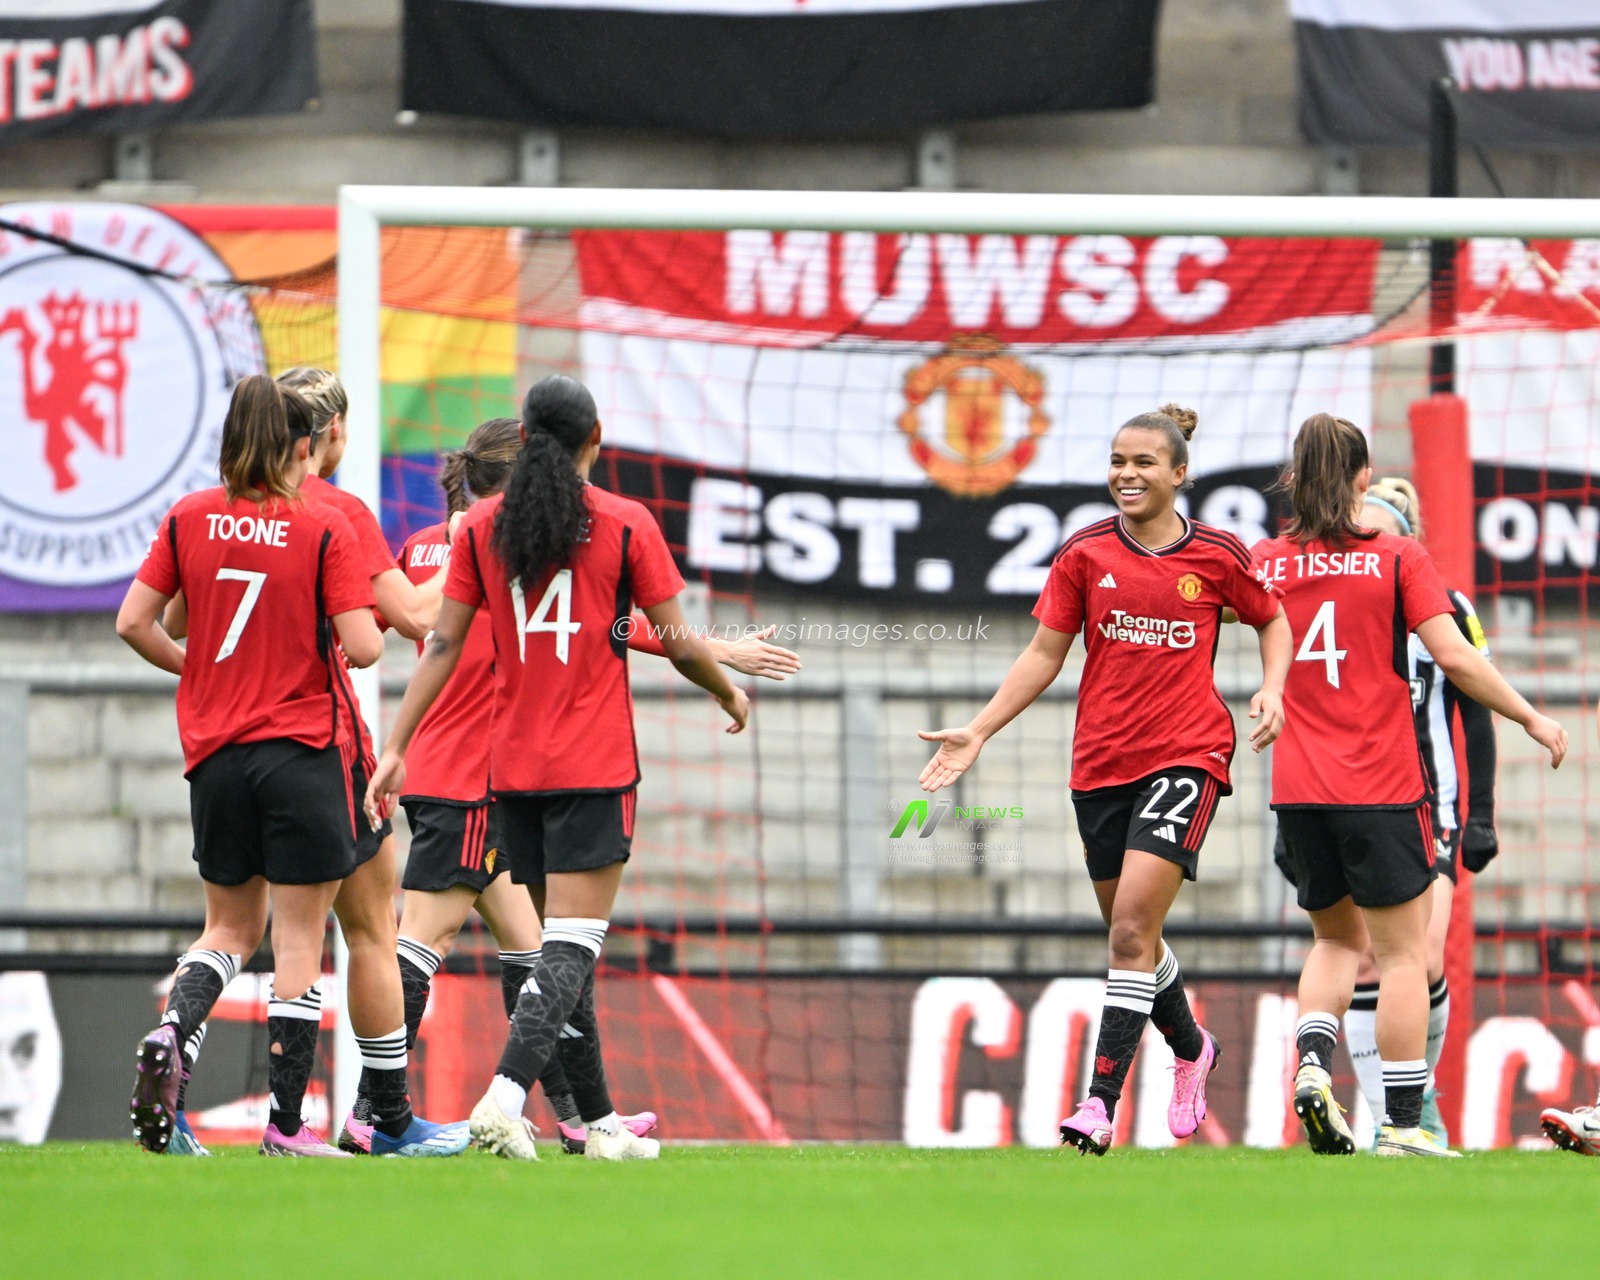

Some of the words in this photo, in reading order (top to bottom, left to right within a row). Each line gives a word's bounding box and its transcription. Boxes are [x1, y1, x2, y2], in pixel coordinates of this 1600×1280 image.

[1441, 37, 1525, 92] YOU
[725, 229, 1230, 329] MUWSC
[206, 513, 291, 548] TOONE
[686, 478, 954, 592] EST.
[1478, 497, 1600, 568] ON
[1263, 557, 1287, 582] LE
[1294, 552, 1382, 579] TISSIER
[215, 567, 268, 663] 7
[508, 568, 582, 665] 14
[1097, 622, 1167, 646] Viewer
[1110, 609, 1168, 632] Team
[1295, 600, 1348, 689] 4
[1139, 777, 1199, 825] 22
